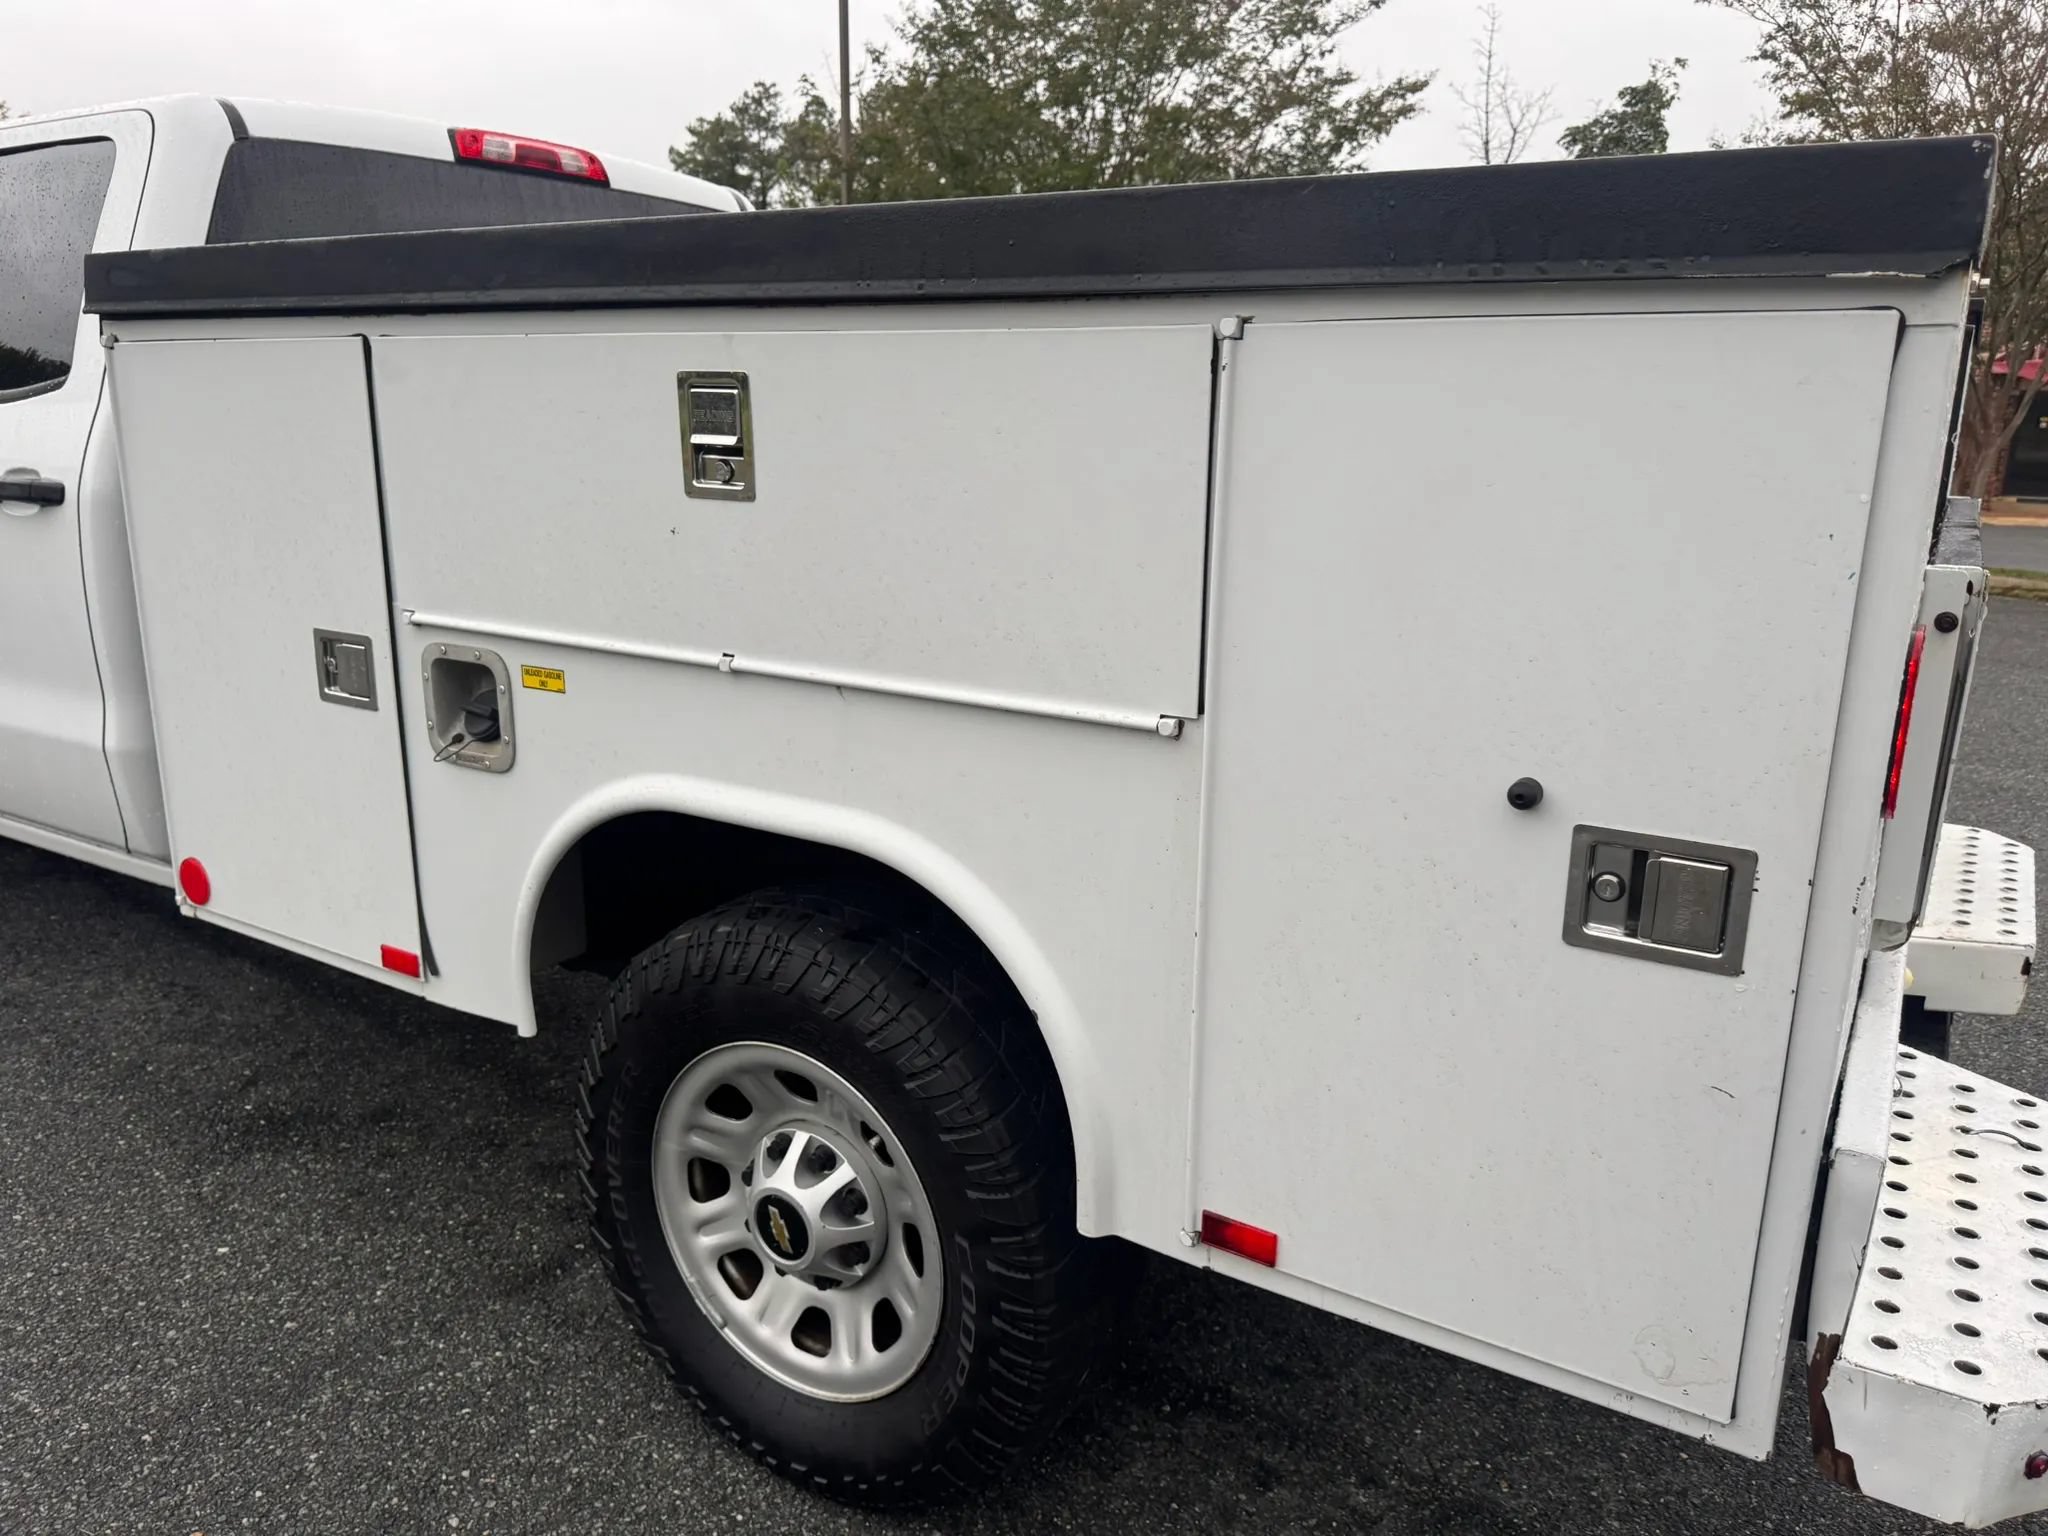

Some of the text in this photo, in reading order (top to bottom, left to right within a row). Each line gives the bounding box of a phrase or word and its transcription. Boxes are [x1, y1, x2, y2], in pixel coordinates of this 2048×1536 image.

[523, 667, 562, 681] UNLEADED GASOLINE
[538, 679, 549, 688] ONLY
[920, 1232, 976, 1437] COOPER
